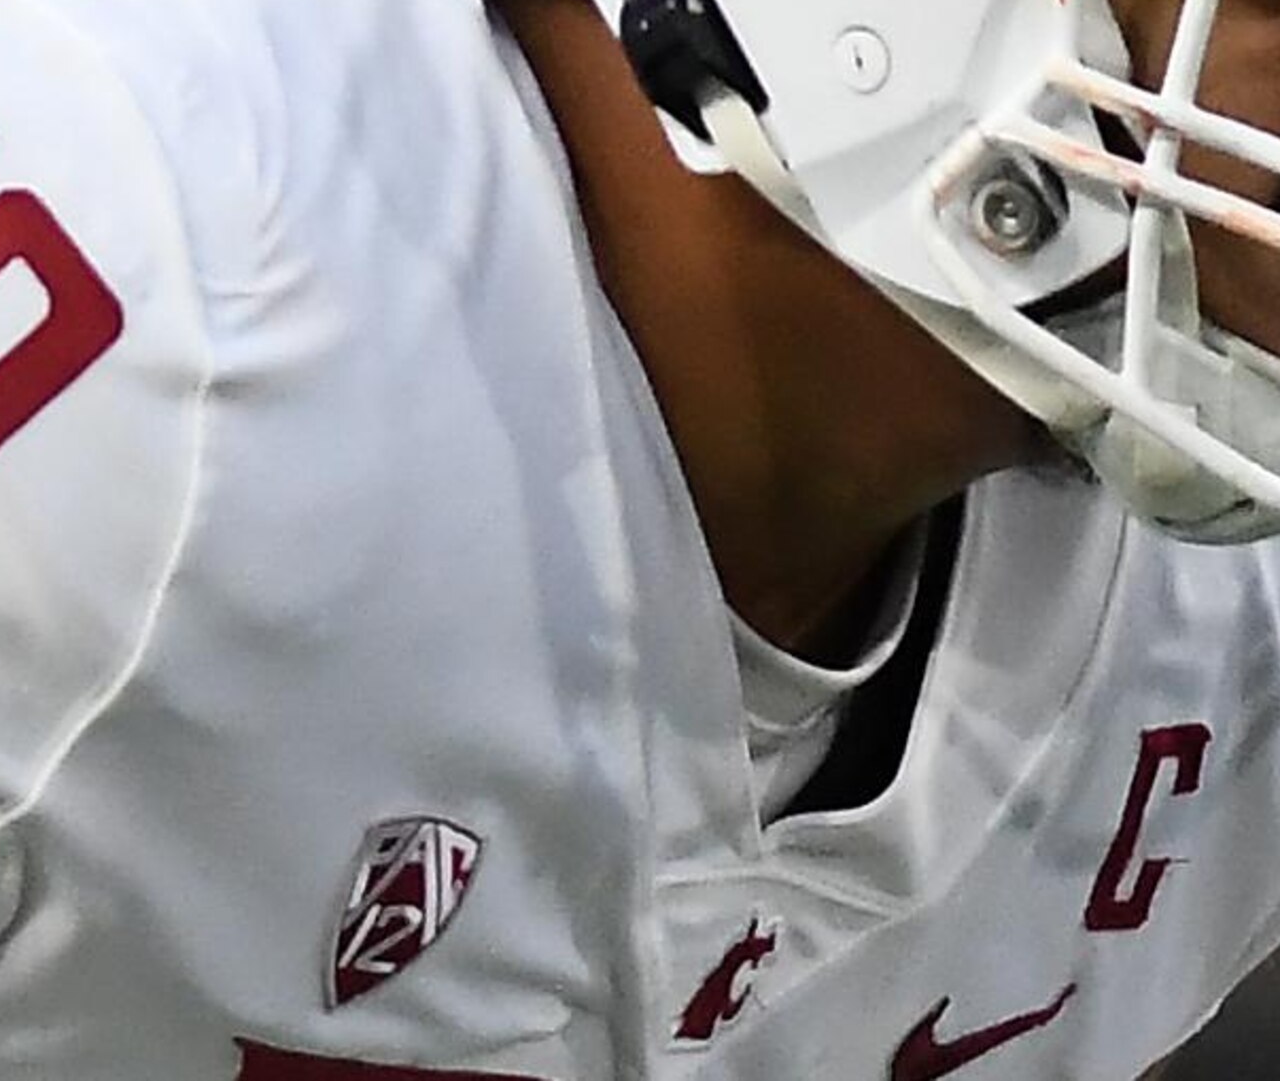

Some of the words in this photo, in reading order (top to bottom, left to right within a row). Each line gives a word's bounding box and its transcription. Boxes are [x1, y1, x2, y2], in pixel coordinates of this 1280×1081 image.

[342, 820, 478, 947] PAC
[1085, 723, 1211, 931] C
[338, 903, 424, 974] 12
